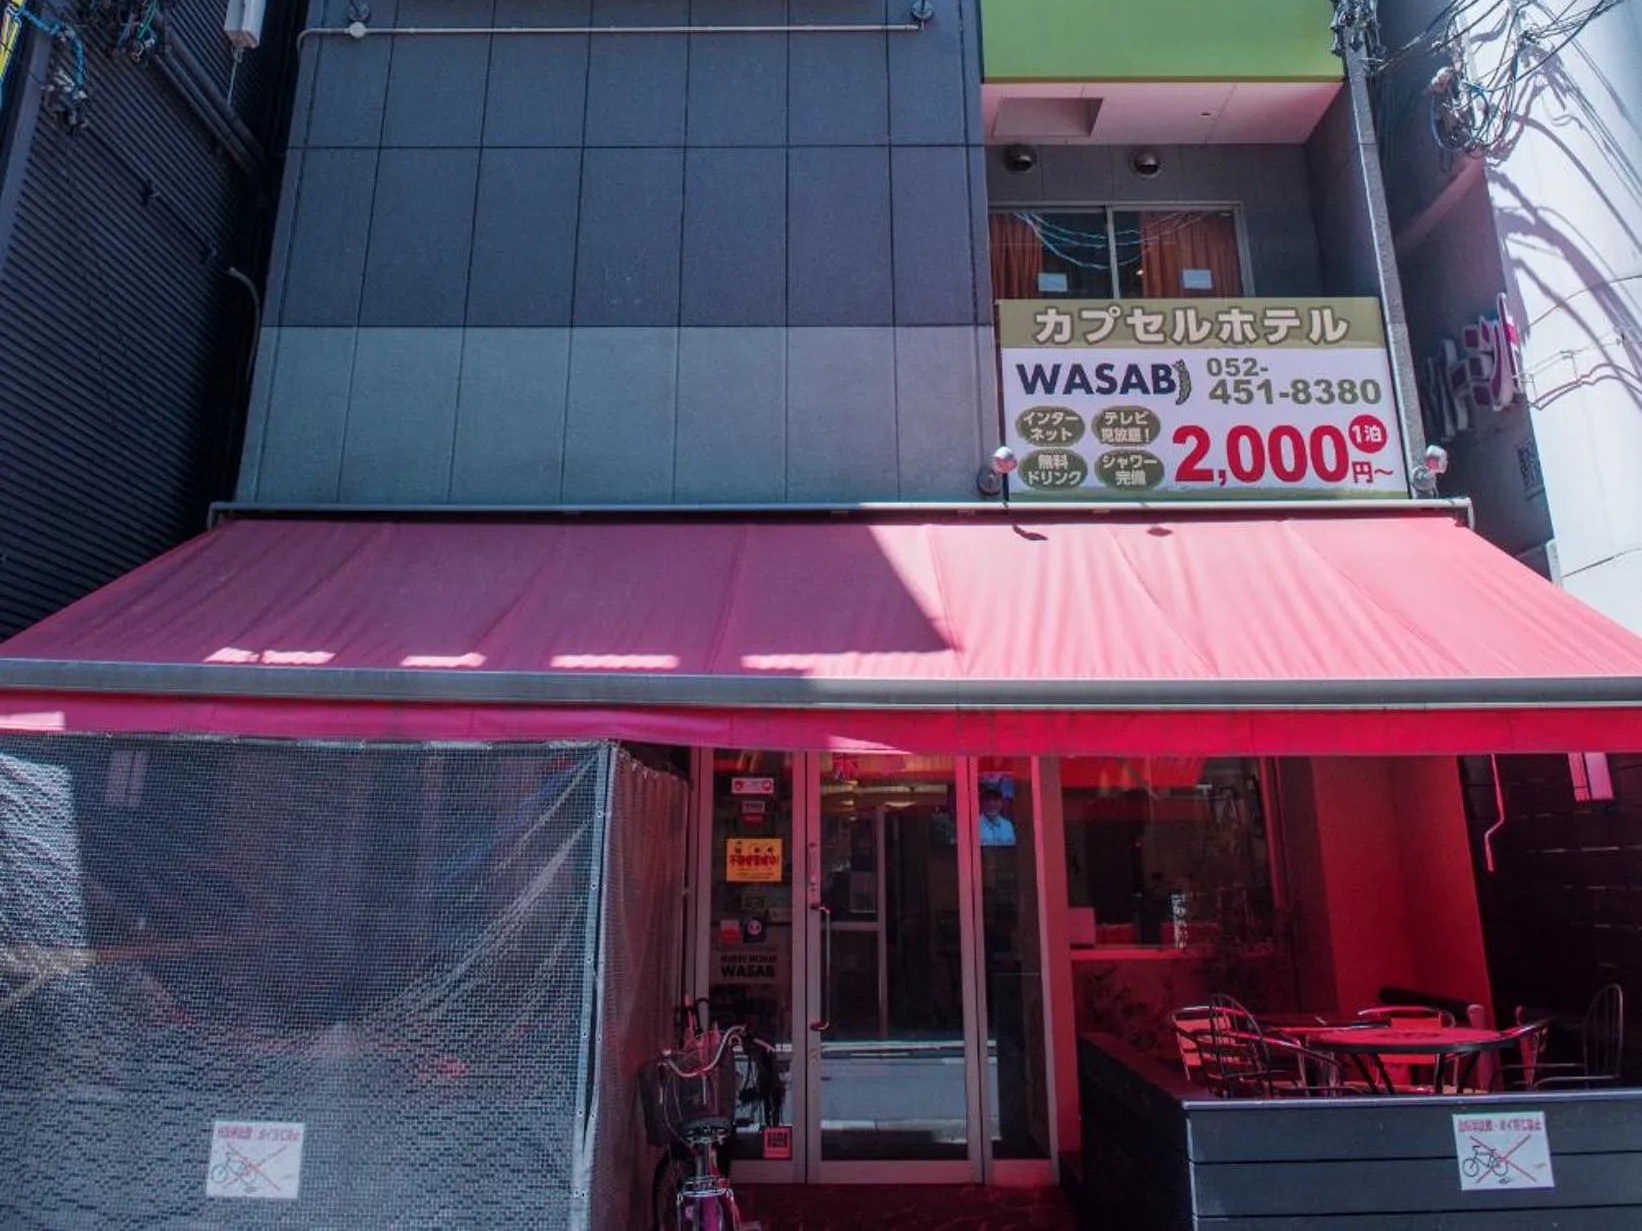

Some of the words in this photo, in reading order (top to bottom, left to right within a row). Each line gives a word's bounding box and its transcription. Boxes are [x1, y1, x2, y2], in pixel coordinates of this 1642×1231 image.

[1035, 306, 1350, 346] カプセルホテル
[1206, 357, 1269, 377] 052-
[1208, 378, 1382, 405] 451-8380
[1023, 411, 1079, 426] インター
[1104, 411, 1149, 425] テレビ
[1030, 428, 1073, 442] ネット
[1350, 424, 1383, 444] 1泊
[1038, 454, 1069, 469] 無料
[1102, 454, 1158, 469] シャワー
[1172, 423, 1349, 487] 2,000
[1027, 470, 1082, 486] ドリンク
